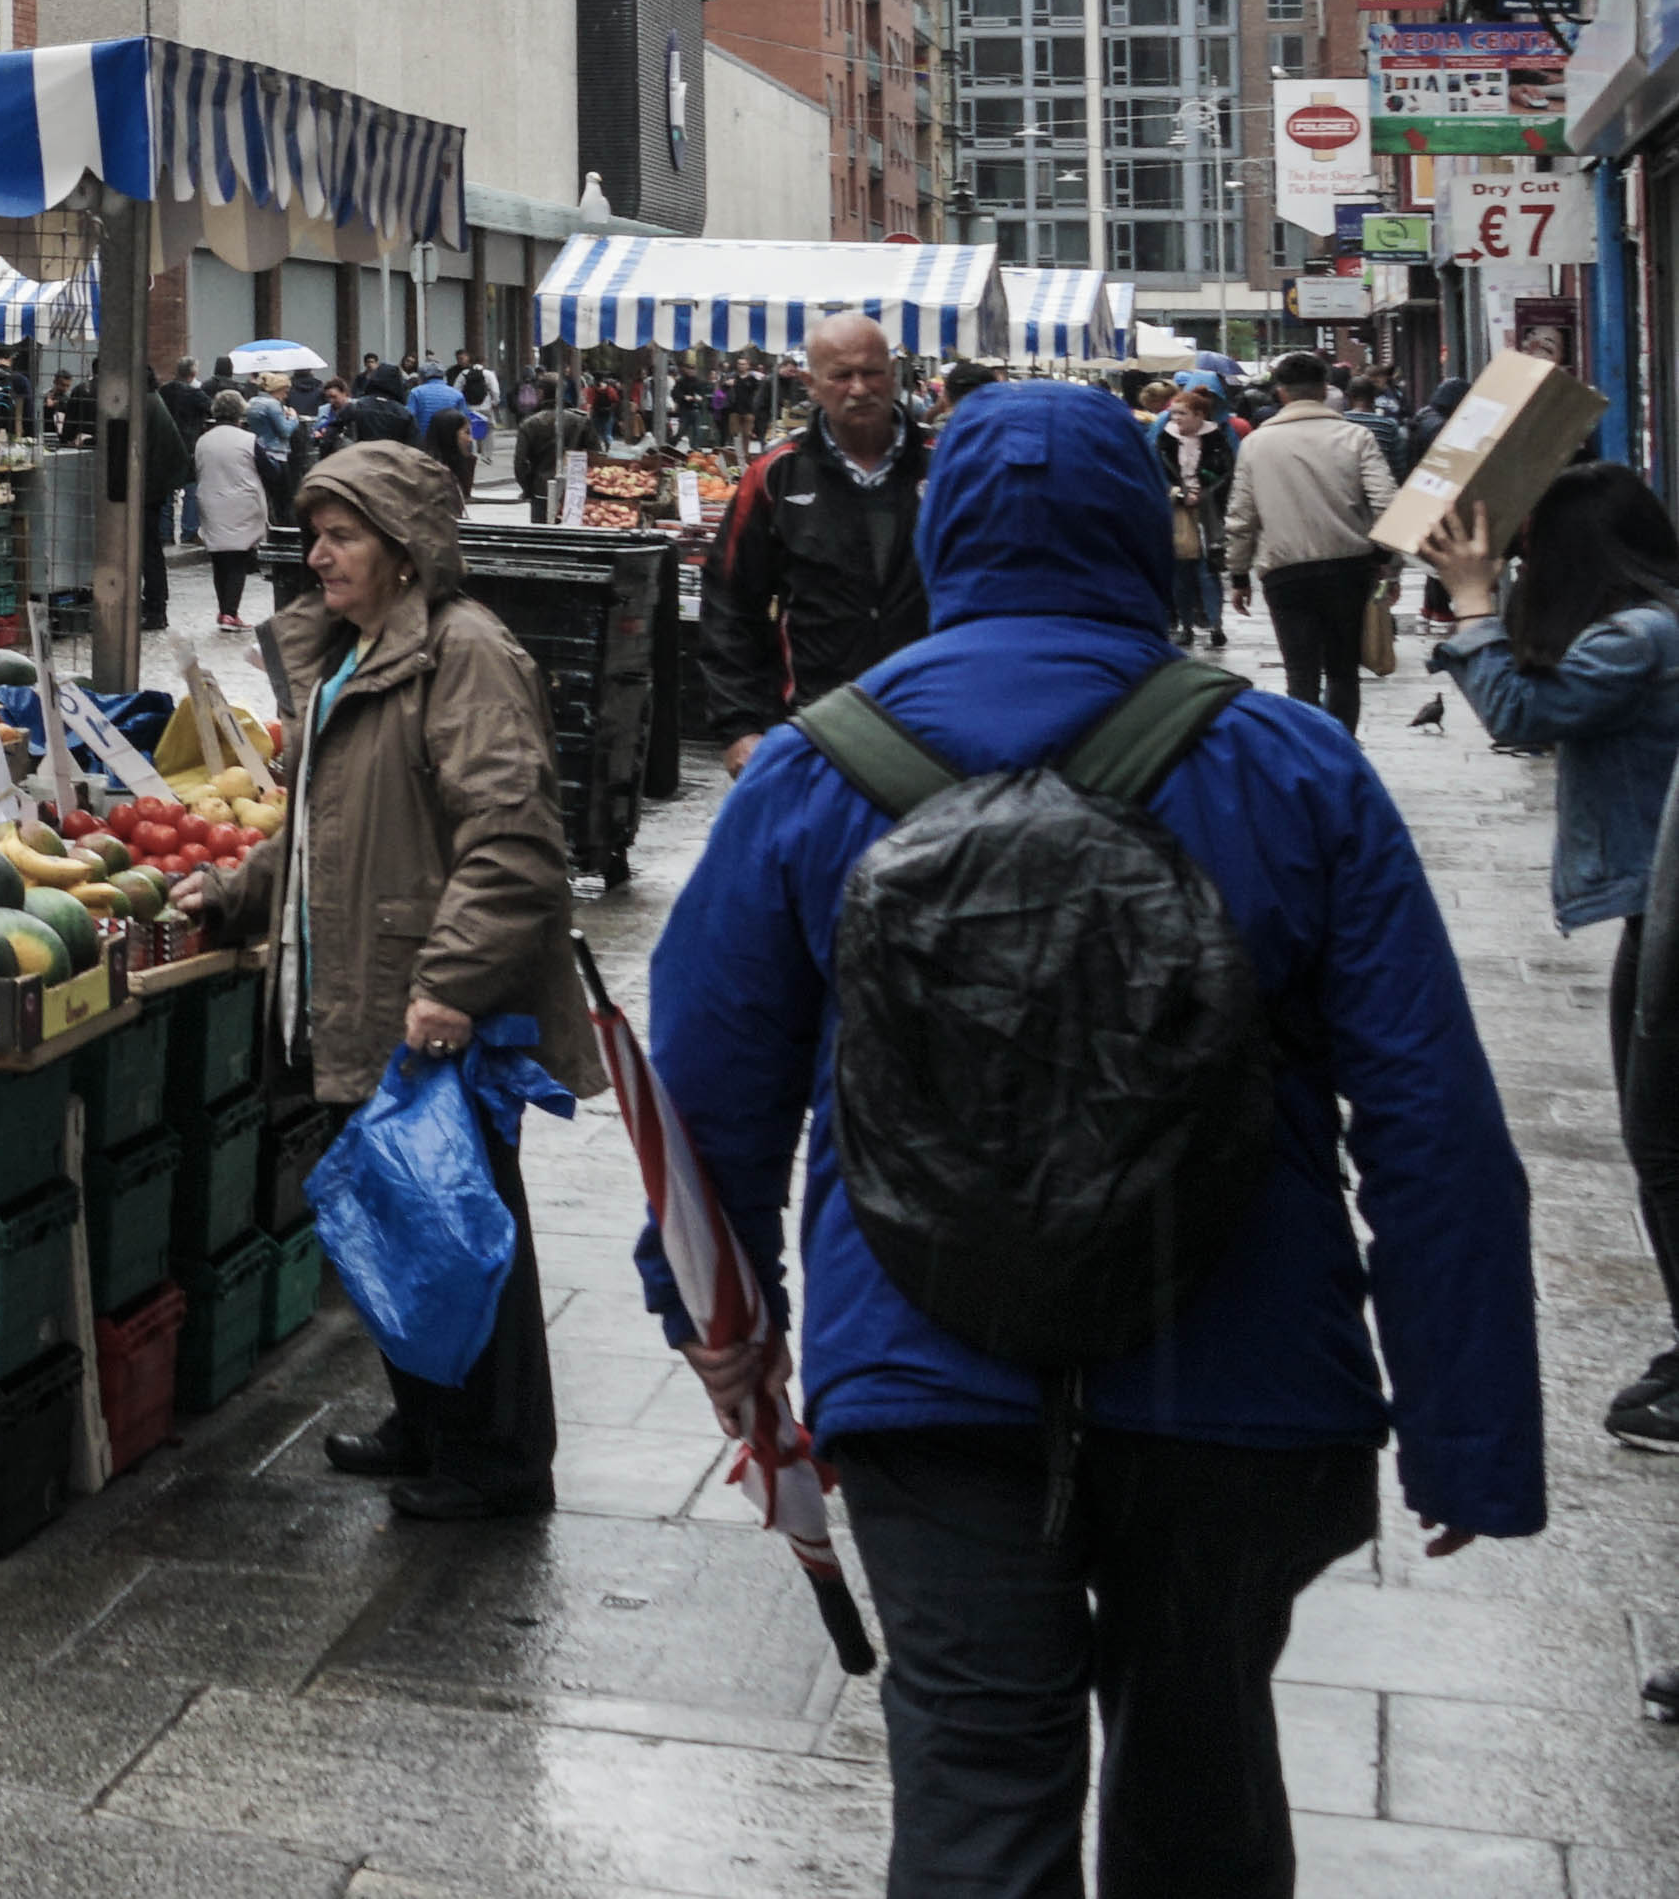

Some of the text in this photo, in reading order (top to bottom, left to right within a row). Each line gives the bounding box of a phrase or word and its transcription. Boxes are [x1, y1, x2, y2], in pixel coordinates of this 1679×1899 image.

[1379, 31, 1463, 51] MEDIA
[1471, 181, 1560, 197] Dry Cut
